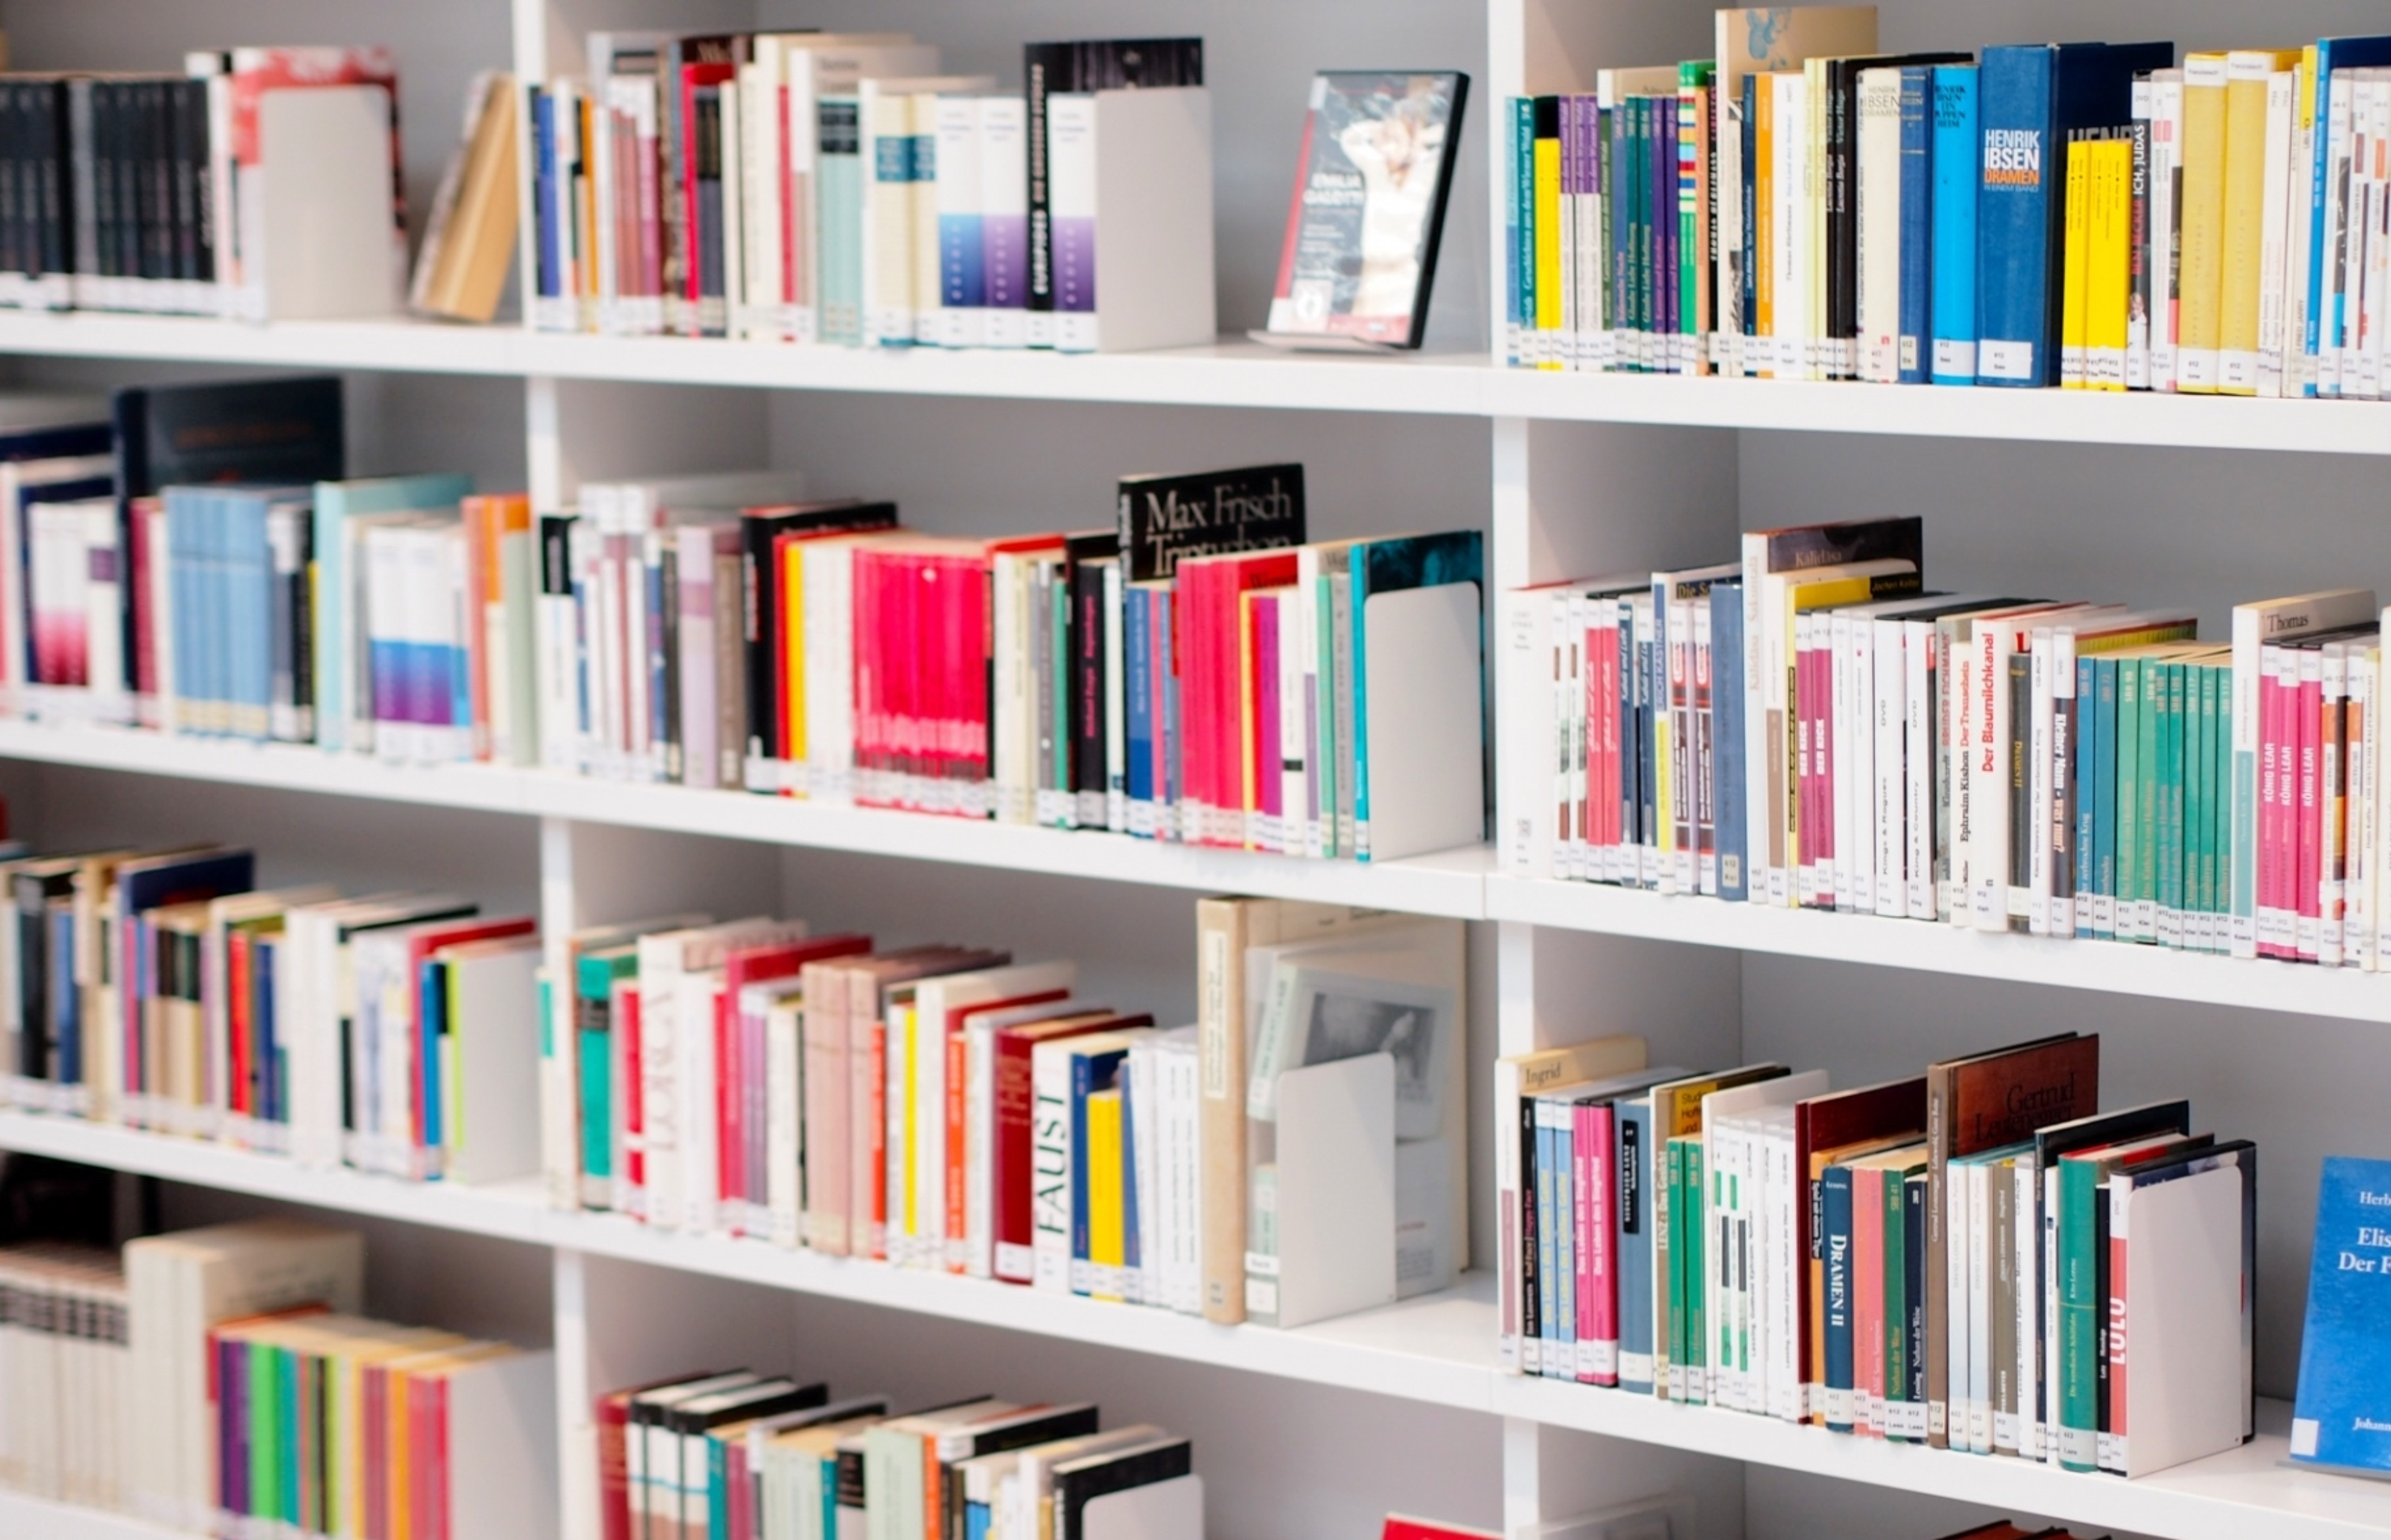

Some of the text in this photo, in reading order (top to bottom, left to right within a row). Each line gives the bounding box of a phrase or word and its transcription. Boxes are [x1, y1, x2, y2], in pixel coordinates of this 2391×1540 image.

[1864, 95, 1901, 108] IBSEN
[1032, 117, 1045, 178] GROSSEN
[1984, 128, 2040, 149] HENRIK
[1984, 147, 2039, 171] IBSEN
[1984, 169, 2040, 185] DRAMEN
[1032, 180, 1045, 202] DIE
[2131, 124, 2147, 275] BEN BECKER ICH, JUDAS
[1032, 210, 1048, 293] EURIPIDES
[1628, 266, 1637, 289] Liebe
[1642, 268, 1652, 291] Liebe
[1145, 477, 1292, 533] Max Frisch
[2267, 613, 2309, 632] Thomas
[1621, 654, 1629, 671] und
[1654, 618, 1665, 711] ERICH KÄSTNER
[1941, 633, 1950, 695] EICHMANN
[1941, 699, 1950, 746] BRUDER
[1981, 633, 1994, 772] Der Blaumilchkanal
[2158, 695, 2166, 713] SBB
[2172, 696, 2181, 713] SBB
[1798, 720, 1808, 749] KICK
[1816, 718, 1826, 776] DER KICK
[1959, 660, 1971, 842] Ephraim Kishon Der Trauschein
[2034, 728, 2044, 747] Krug
[1798, 752, 1809, 776] DER
[2014, 741, 2023, 781] DRAMEN
[2263, 743, 2276, 802] KÖNIG LEAR
[2280, 747, 2293, 805] KÖNIG LEAR
[2302, 748, 2314, 807] KÖNIG LEAR
[1880, 776, 1889, 824] Rogues
[2053, 713, 2067, 853] Kleiner Mann was nun?
[1912, 780, 1922, 832] Country
[1881, 840, 1890, 876] Kings
[1913, 848, 1922, 878] King
[1526, 1064, 1562, 1086] Ingrid
[2006, 1072, 2075, 1115] Gertrud
[1681, 1120, 1697, 1134] und
[1034, 1084, 1065, 1236] FAUST
[1658, 1150, 1668, 1189] Gesicht
[1576, 1156, 1587, 1275] Das Leben des Siegfried
[1592, 1156, 1603, 1275] Das Leben des Siegfried
[1658, 1193, 1668, 1211] Das
[1541, 1169, 1552, 1324] Das Leben des Galileo Galilei
[1559, 1173, 1570, 1328] Das Leben des Galileo Galilei
[2357, 1227, 2391, 1247] Elis
[1830, 1234, 1847, 1326] DRAMEN II
[2068, 1258, 2078, 1283] Lorenc
[2338, 1252, 2375, 1274] Der
[2068, 1285, 2077, 1299] Kito
[2109, 1297, 2127, 1364] LULU
[1890, 1326, 1900, 1395] Nathan der Weise
[1913, 1306, 1923, 1399] Lessing Nathan der Weise
[2068, 1348, 2077, 1383] wendische
[2068, 1384, 2078, 1397] Die
